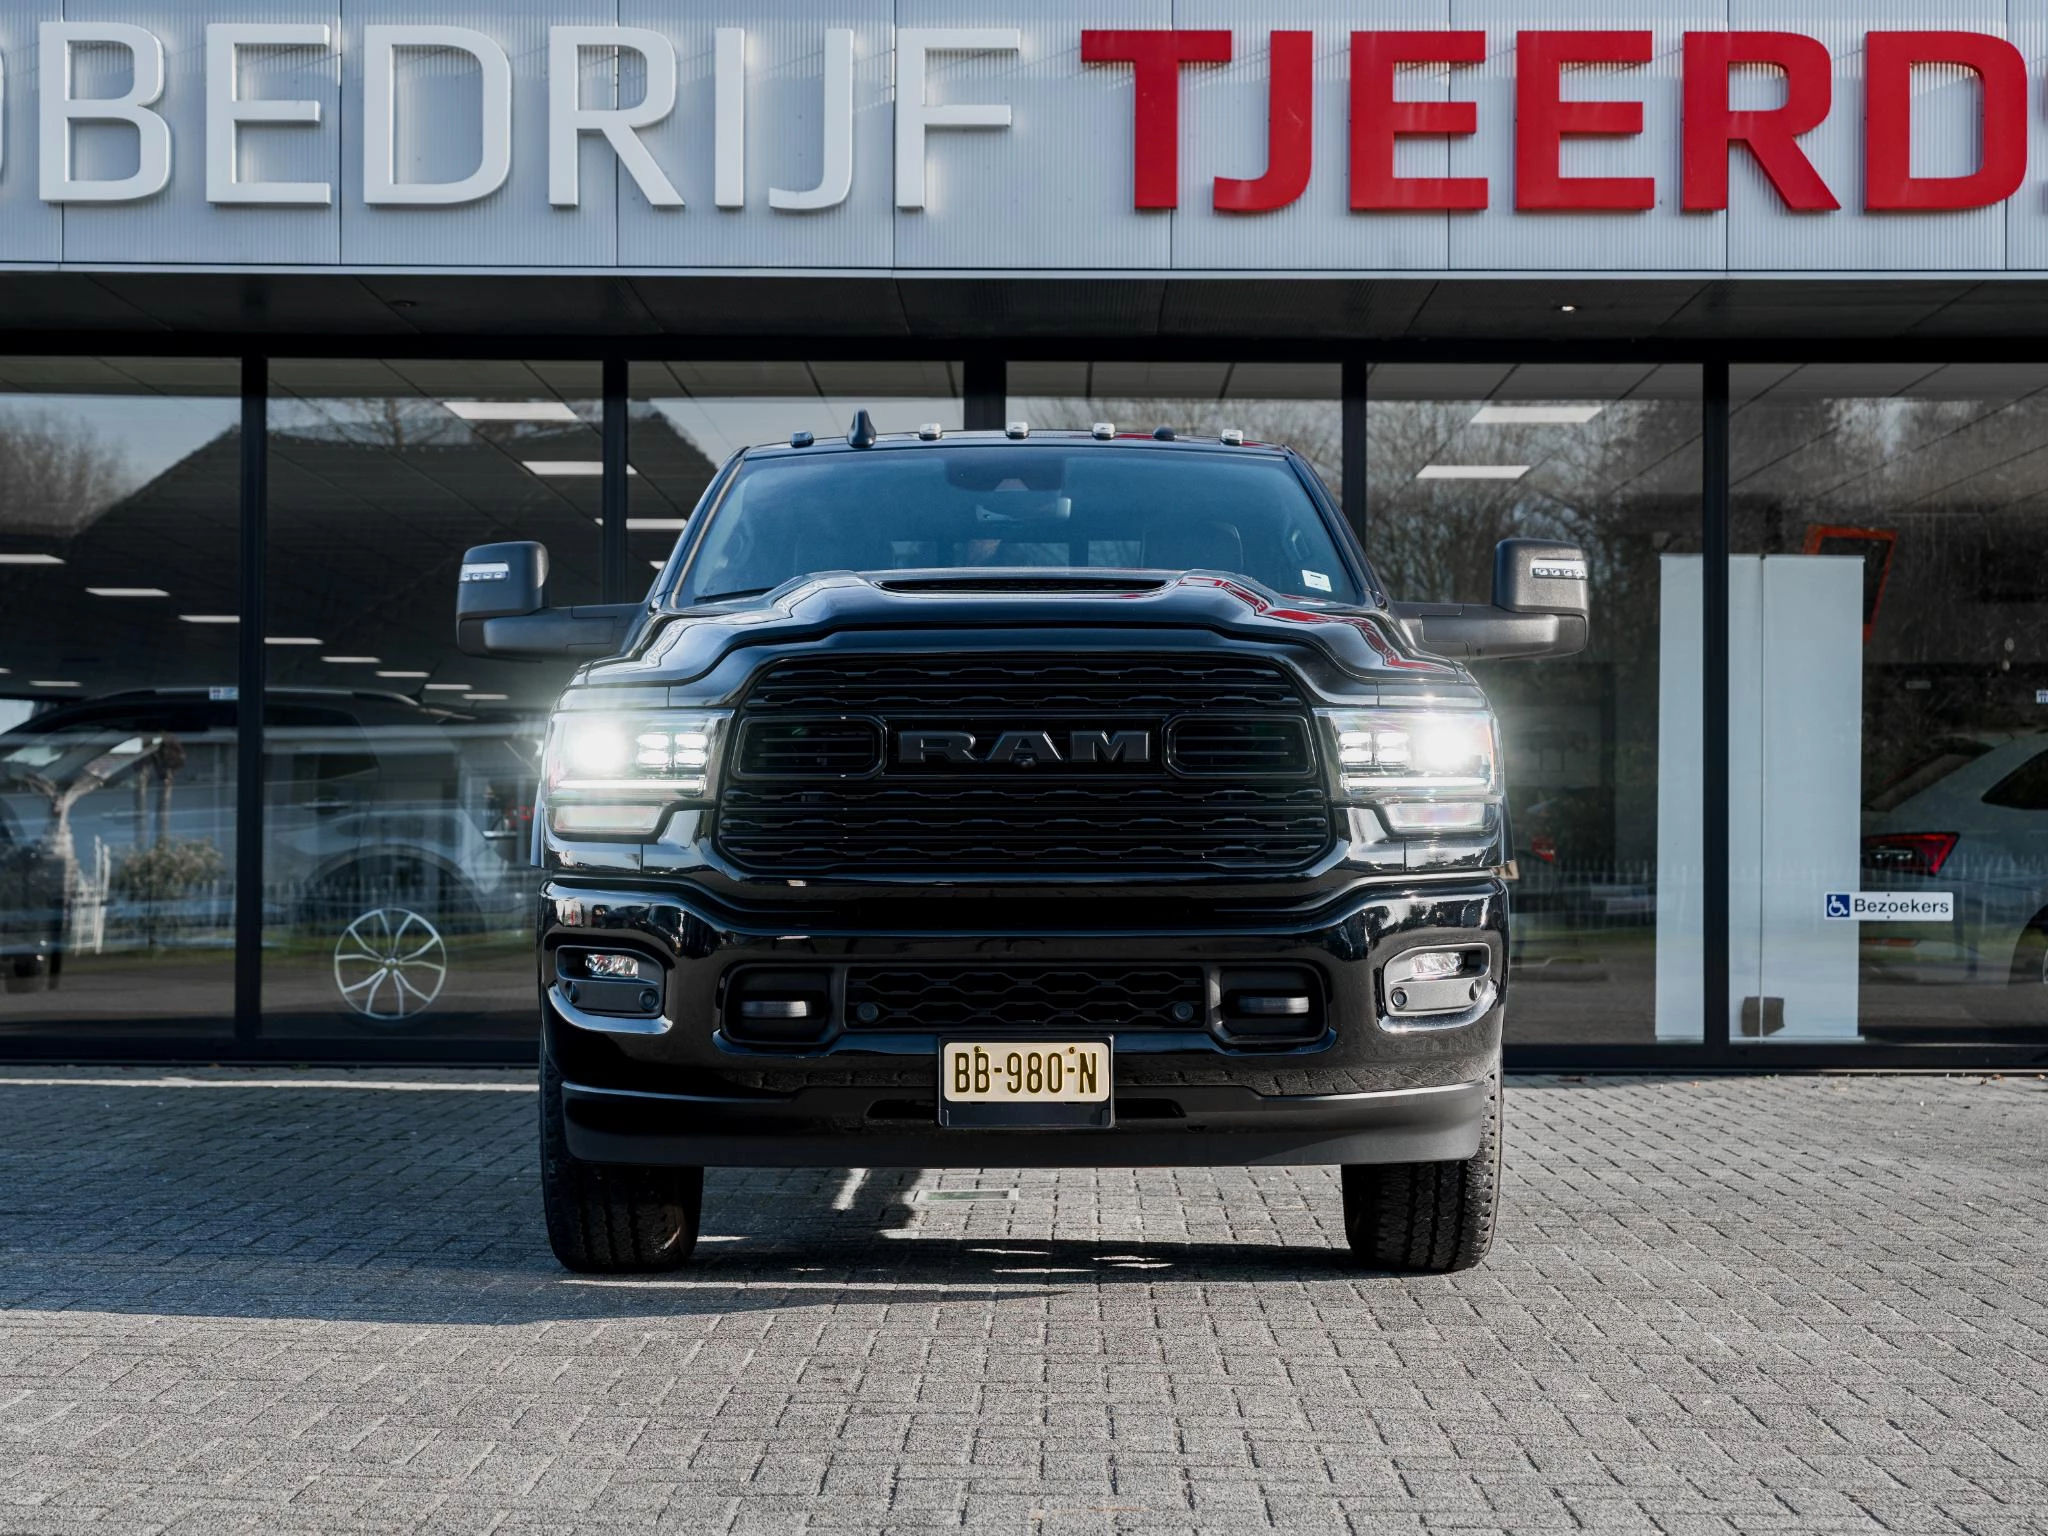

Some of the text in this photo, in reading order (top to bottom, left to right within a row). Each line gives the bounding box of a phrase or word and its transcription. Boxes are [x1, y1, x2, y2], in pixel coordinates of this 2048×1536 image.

[0, 21, 2048, 211] BEDRIJF TJEERD
[900, 731, 1150, 763] RAM
[1854, 898, 1949, 913] Bezoekers
[955, 1052, 1097, 1093] BB-980-N
